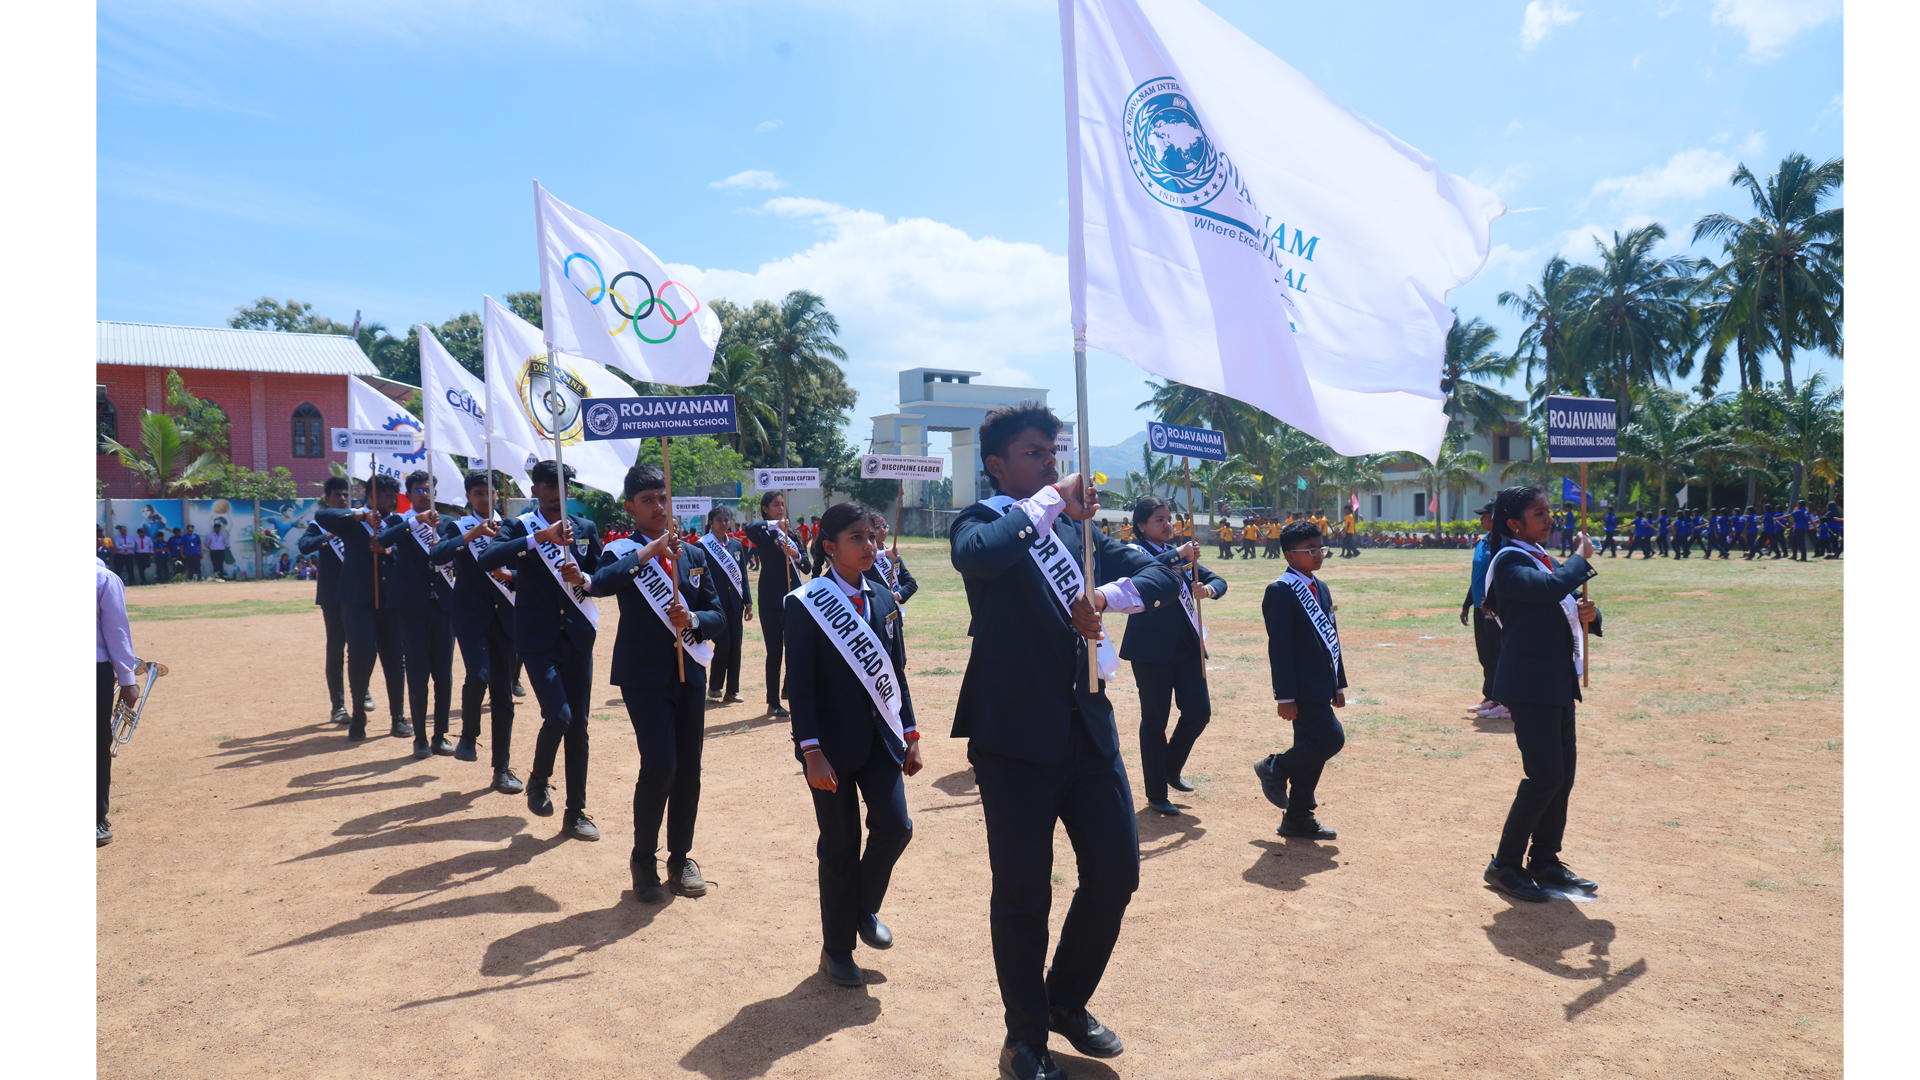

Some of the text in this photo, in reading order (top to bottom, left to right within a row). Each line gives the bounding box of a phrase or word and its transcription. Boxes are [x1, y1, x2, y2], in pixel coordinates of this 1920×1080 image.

[1126, 85, 1157, 126] ROJAVANAM
[1159, 190, 1187, 204] INDIA
[1194, 216, 1236, 239] Where
[620, 399, 729, 417] ROJAVANAM
[622, 417, 730, 430] INTERNATIONAL SCHOOL
[1549, 409, 1617, 430] ROJAVANAM
[1167, 427, 1222, 446] ROJAVANAM
[1550, 435, 1617, 447] INTERNATIONAL SCHOOL
[1168, 441, 1223, 455] INTERNATIONAL SCHOOL
[881, 463, 940, 473] DISCIPLINE LEADER
[707, 540, 732, 565] ASSEMBLY
[1288, 579, 1320, 618] JUNIOR
[1314, 613, 1337, 645] HEAD
[806, 587, 859, 640] JUNIOR
[846, 631, 884, 677] HEAD
